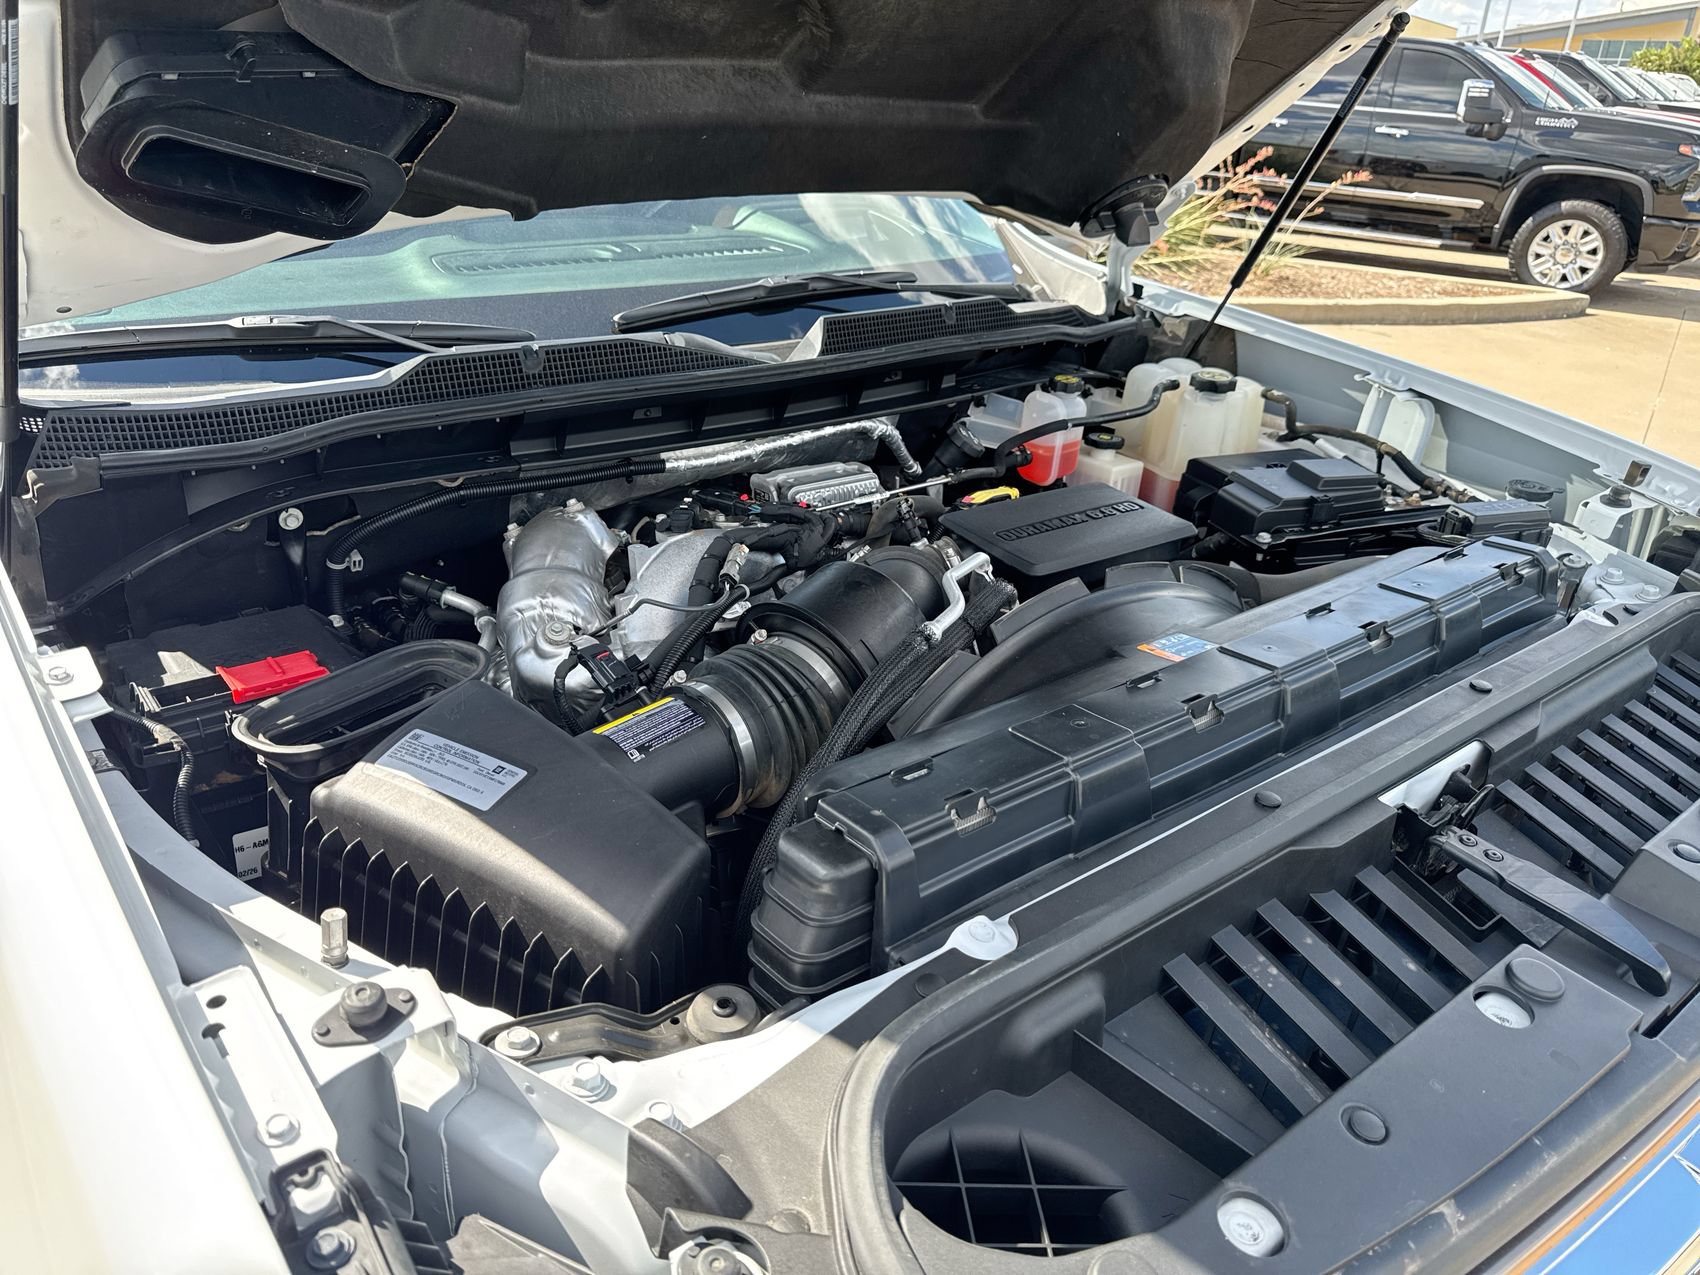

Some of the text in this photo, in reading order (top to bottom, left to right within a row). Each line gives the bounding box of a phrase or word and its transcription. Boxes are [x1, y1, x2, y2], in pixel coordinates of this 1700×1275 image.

[997, 501, 1143, 541] DURAMAX 6.6 HD
